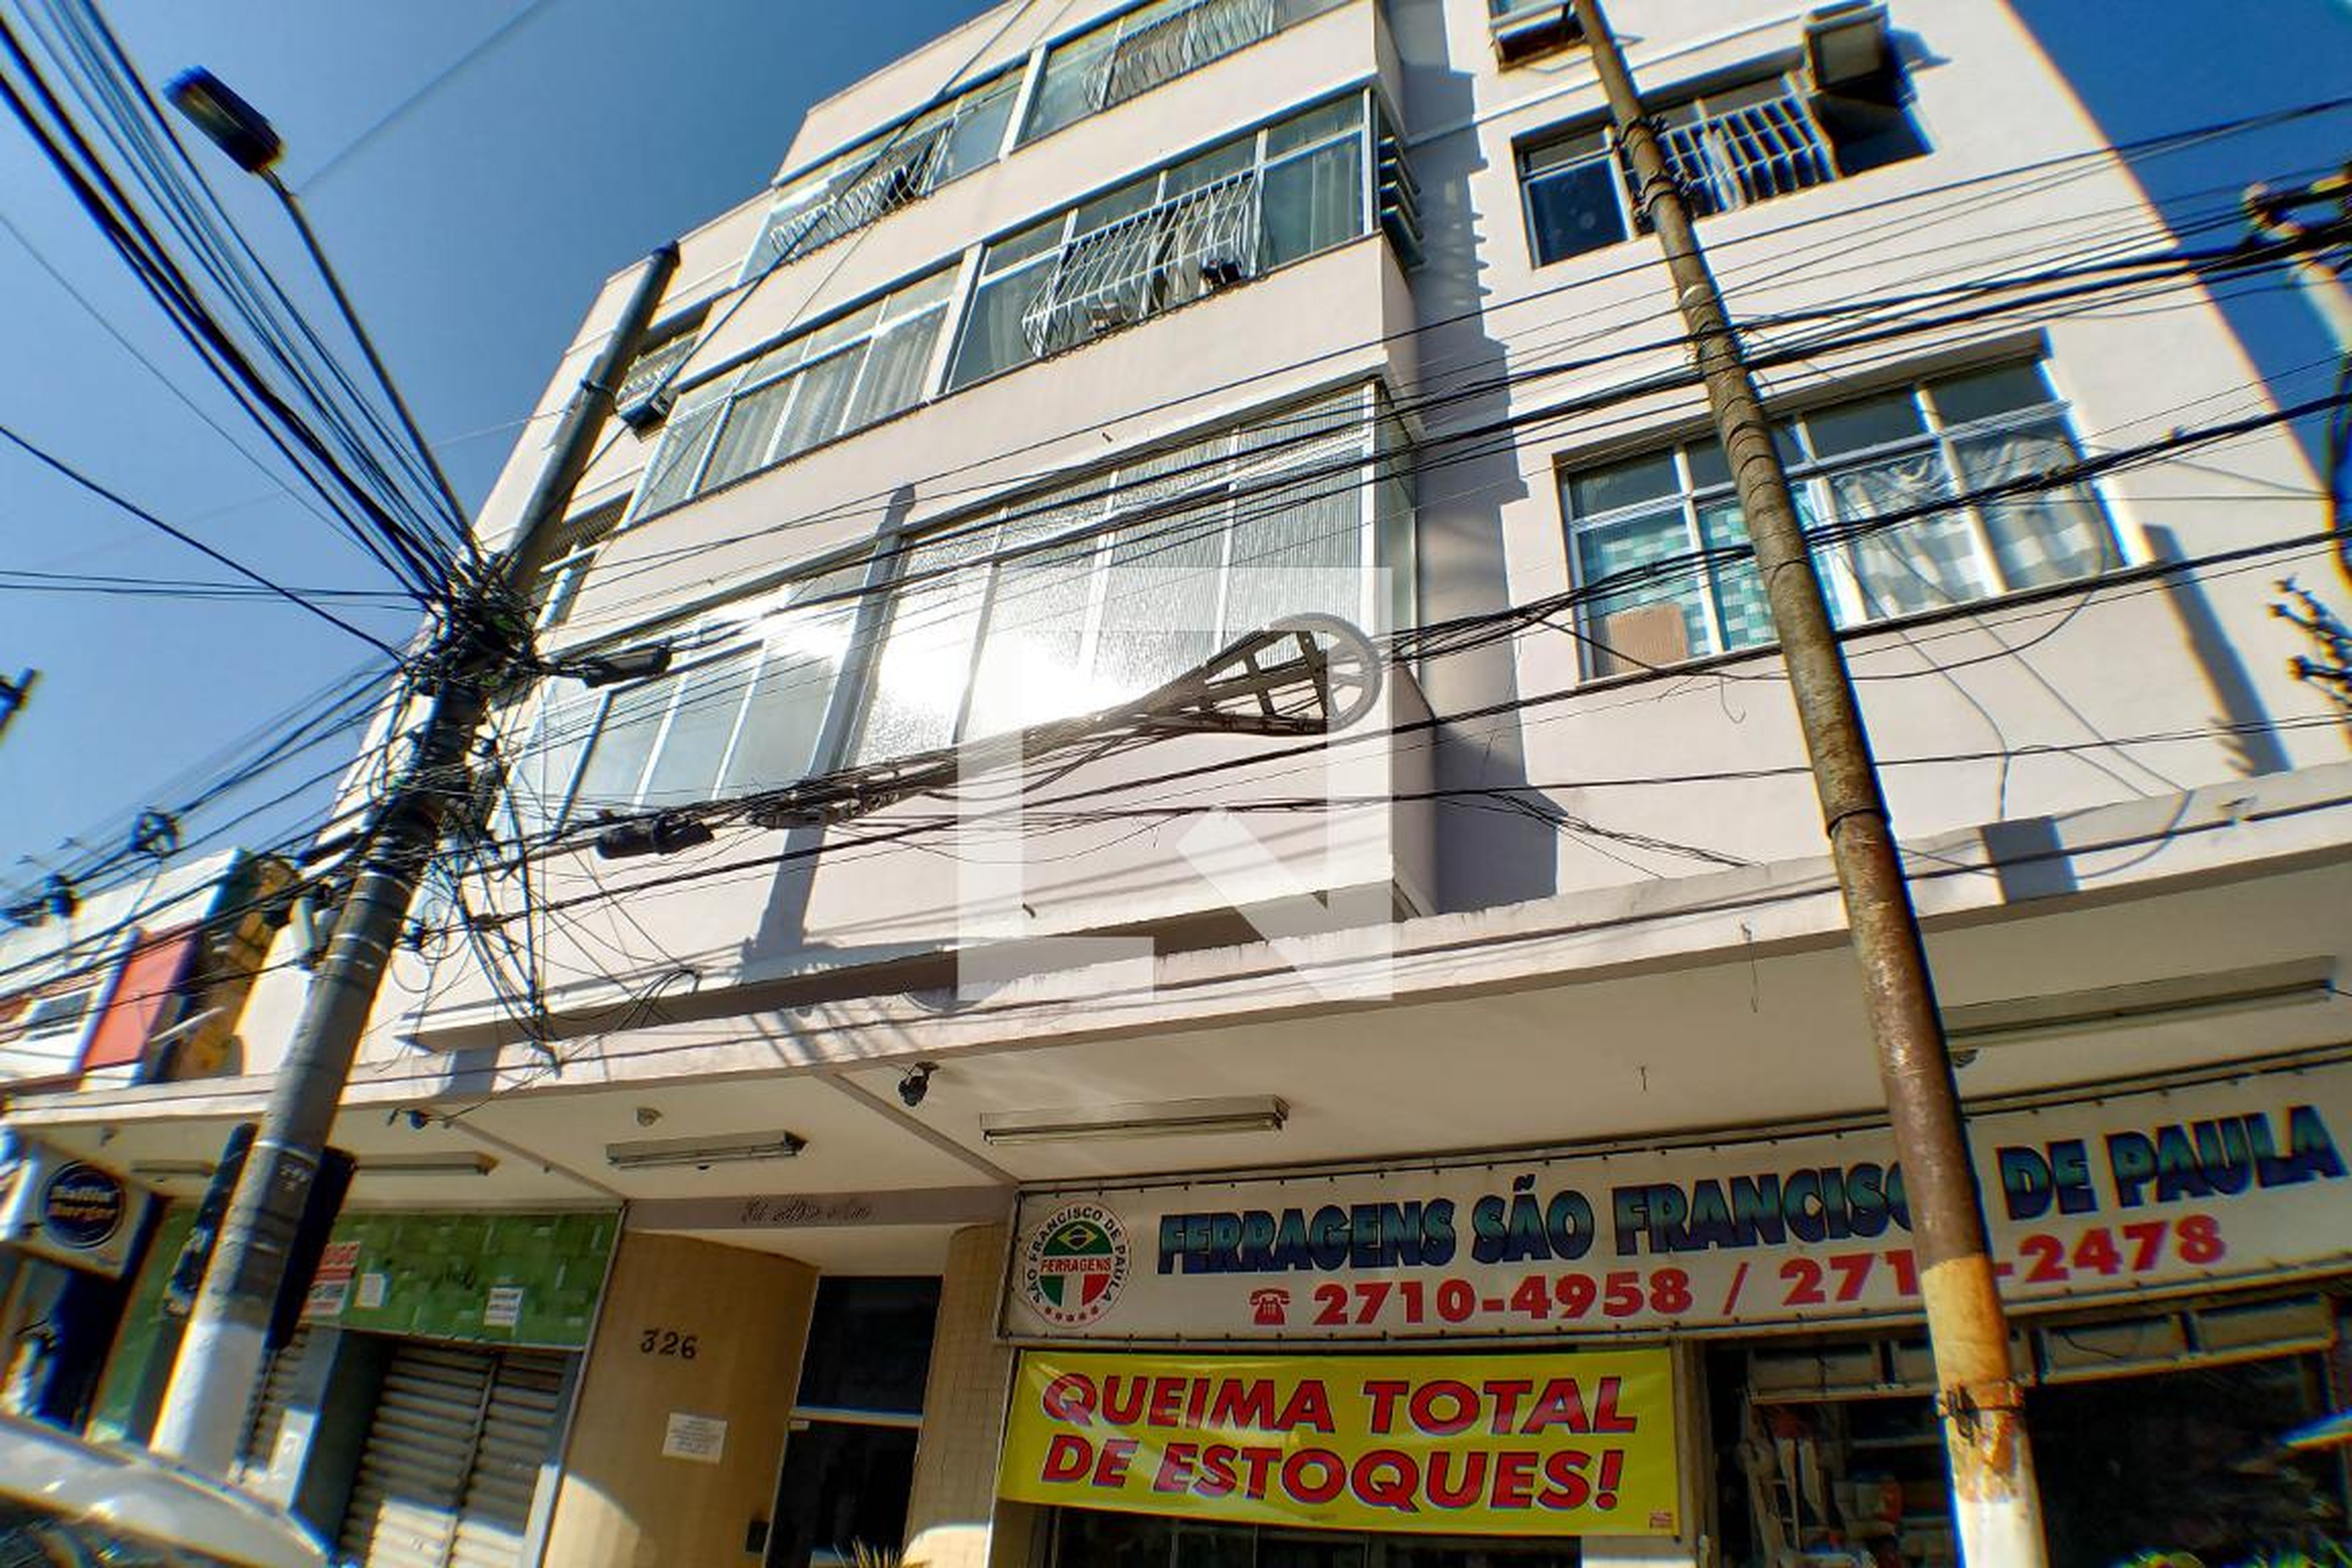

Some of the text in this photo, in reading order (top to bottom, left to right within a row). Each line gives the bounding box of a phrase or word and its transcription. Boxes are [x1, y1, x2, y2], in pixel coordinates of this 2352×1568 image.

[1158, 1105, 2349, 1275] FERRAGENS SÃO FRANCIS DE PAULA
[1028, 1206, 1104, 1262] FRANCISCO
[1104, 1218, 1122, 1242] DE
[1041, 1257, 1112, 1273] FERRAGENS
[1101, 1245, 1126, 1302] PAULA
[1313, 1267, 1693, 1325] 2710-4958
[1779, 1215, 2226, 1307] 271-2478
[641, 1329, 698, 1359] 326
[1042, 1373, 1638, 1435] QUEIMA TOTAL
[1042, 1434, 1624, 1513] DE ESTOQUES!
